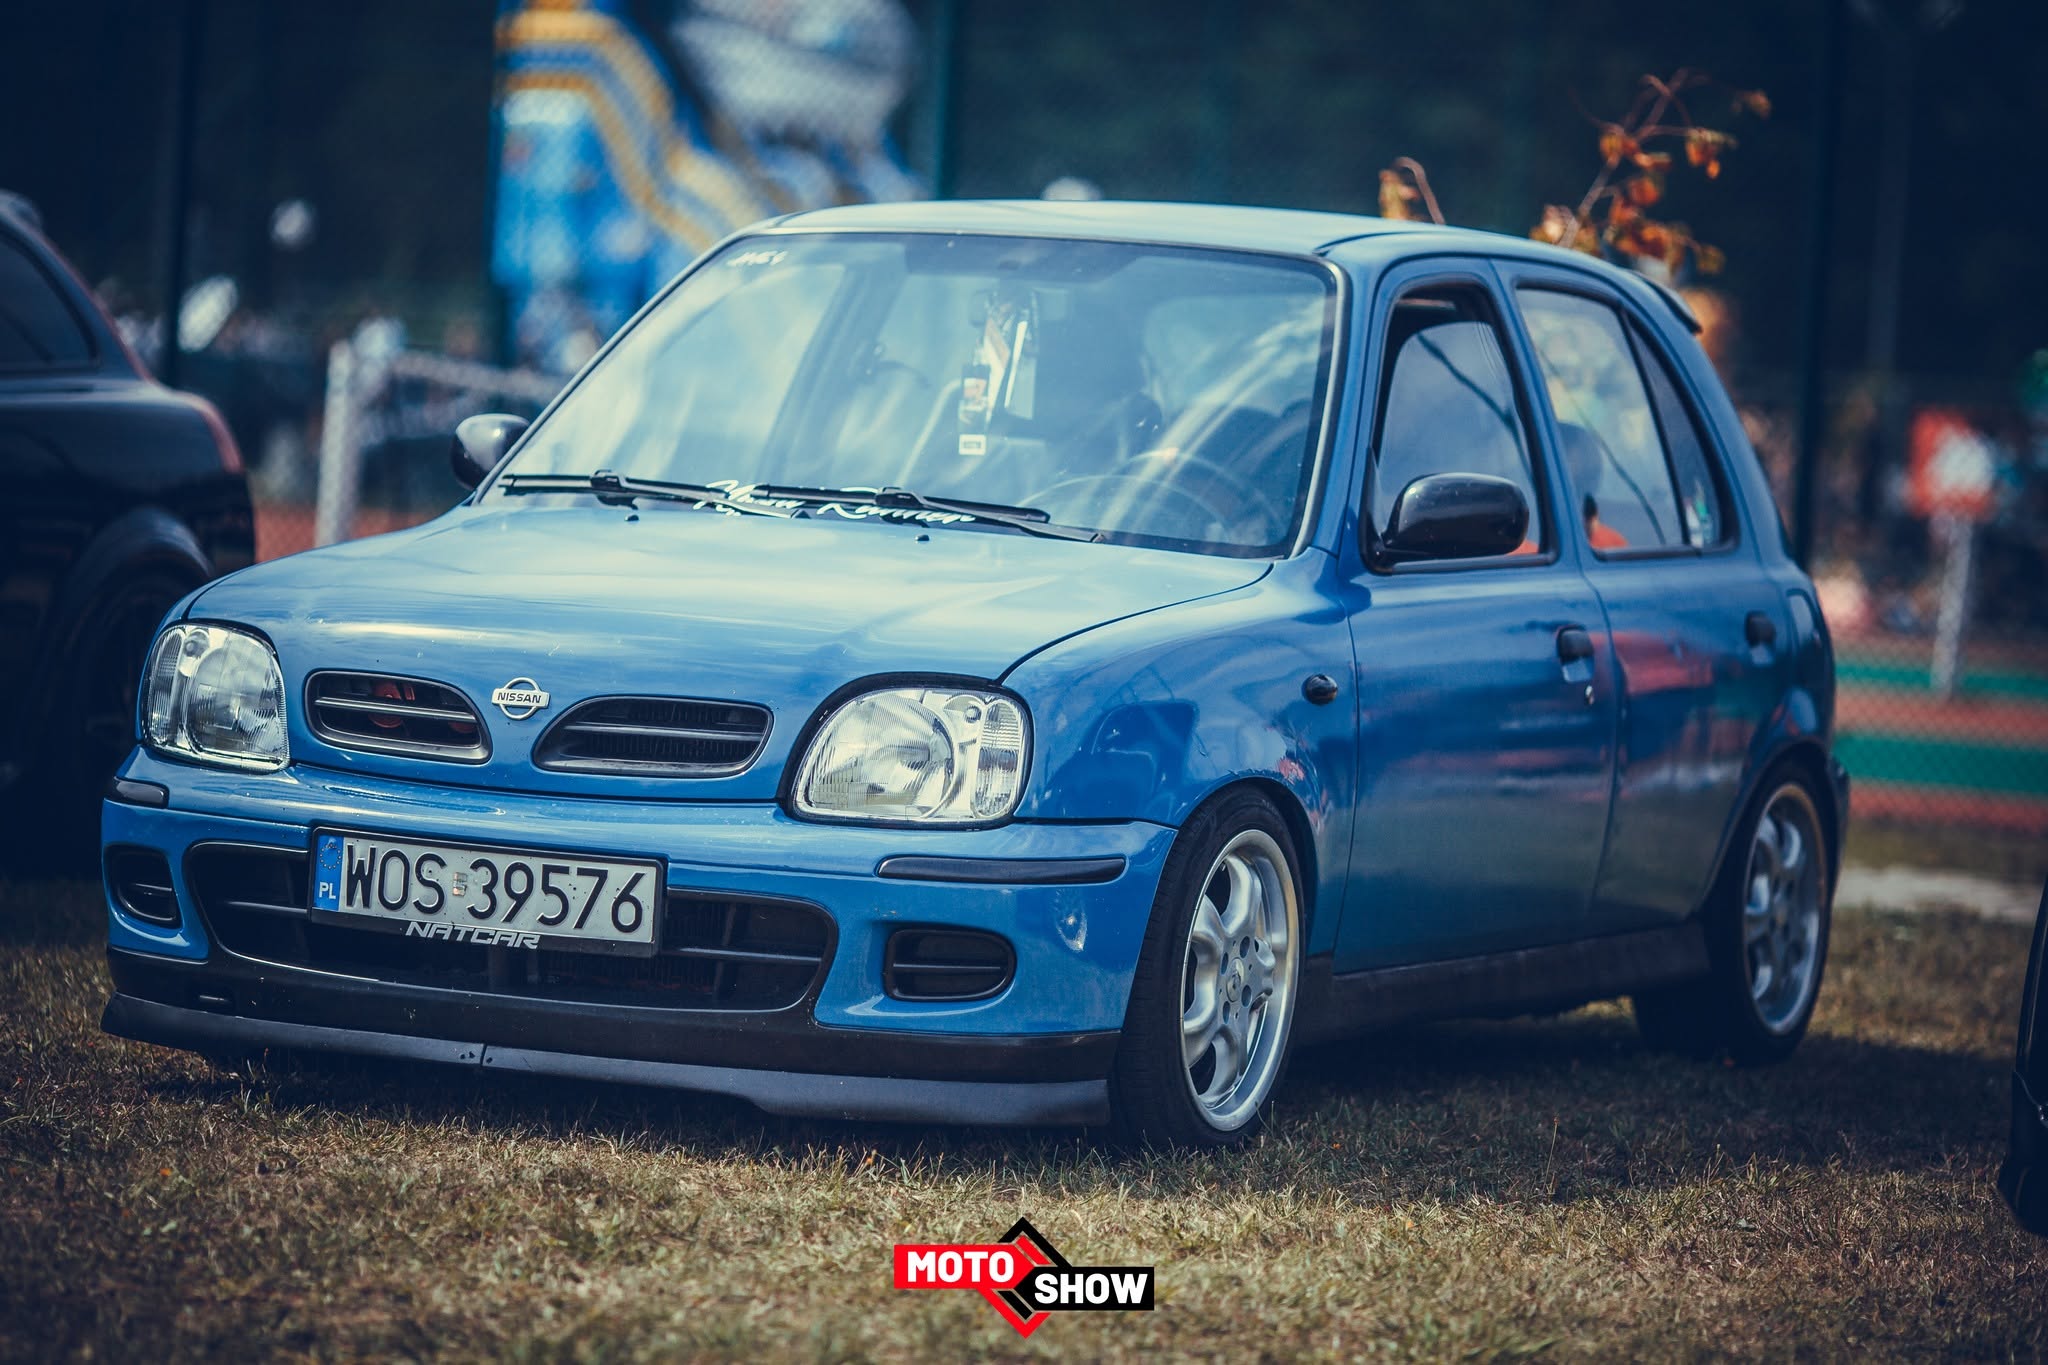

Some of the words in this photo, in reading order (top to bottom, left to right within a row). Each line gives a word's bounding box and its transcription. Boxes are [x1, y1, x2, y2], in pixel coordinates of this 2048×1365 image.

[497, 692, 542, 704] NISSAN
[319, 881, 337, 900] PL
[346, 843, 448, 914] WOS
[466, 857, 646, 934] 39576
[405, 921, 541, 950] NATCAR
